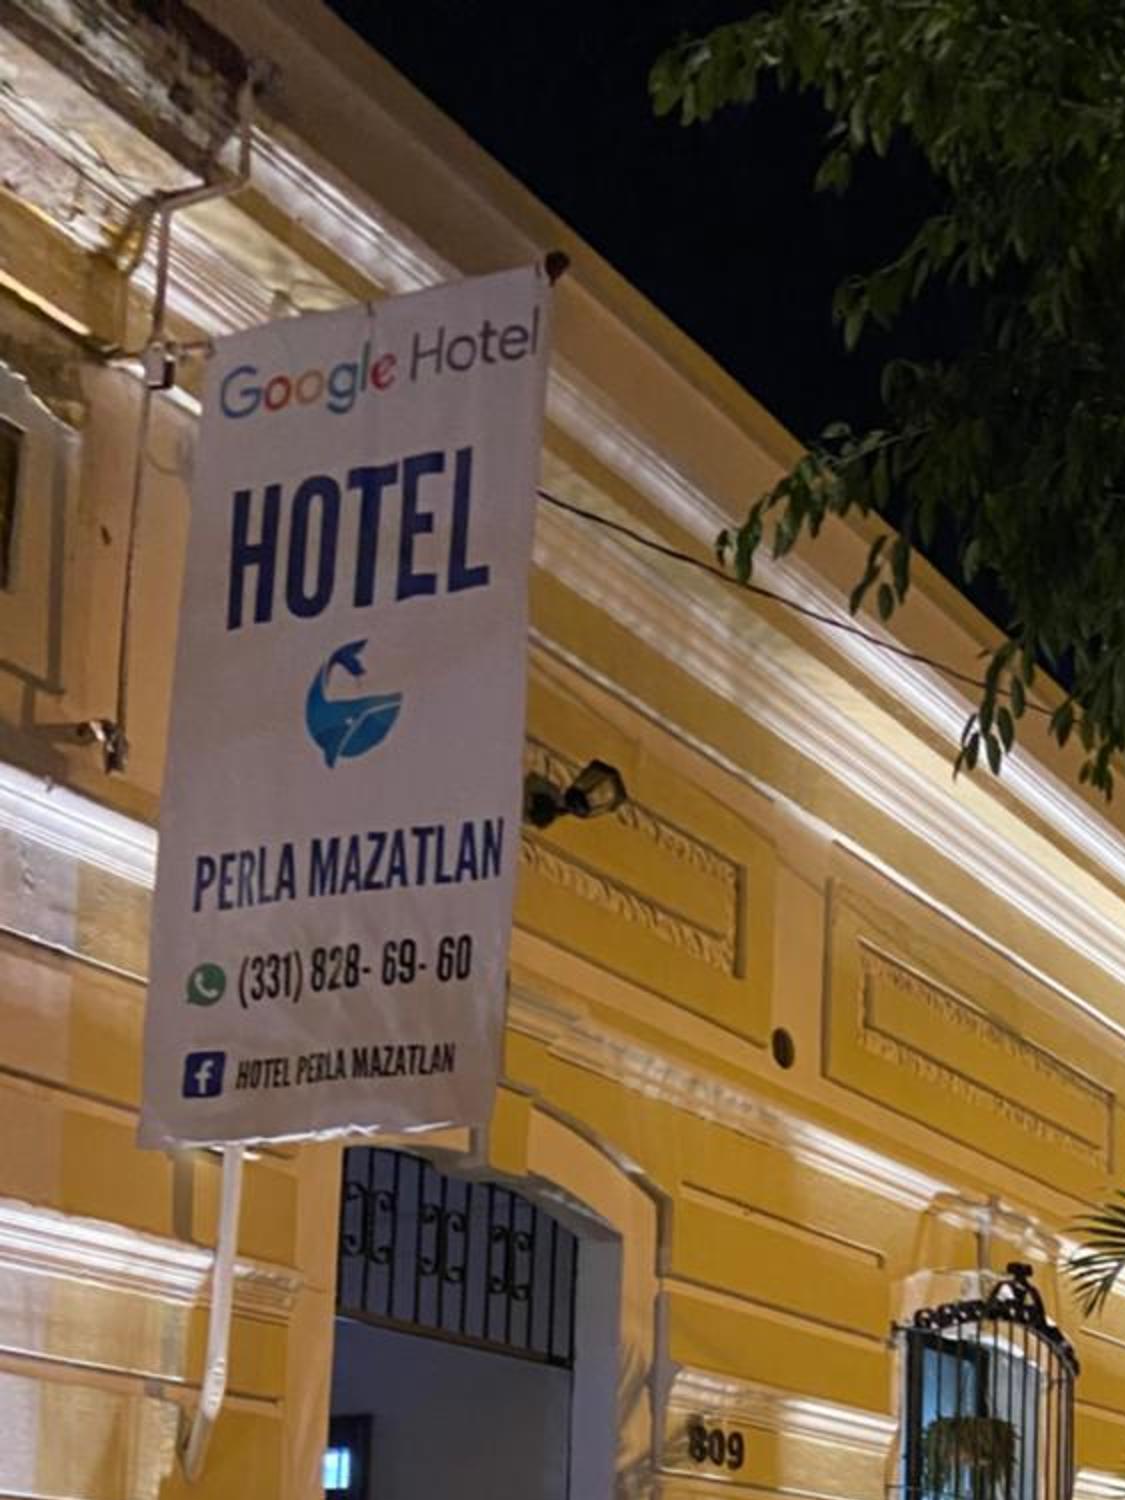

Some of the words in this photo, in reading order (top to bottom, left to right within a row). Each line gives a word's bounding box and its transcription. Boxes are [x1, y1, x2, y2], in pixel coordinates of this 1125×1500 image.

[219, 340, 397, 419] Google
[410, 305, 541, 381] Hotel
[226, 446, 490, 631] HOTEL
[192, 842, 296, 913] PERLA
[308, 816, 505, 898] MAZATLAN
[238, 949, 303, 1010] (331)
[436, 933, 473, 983] 60
[234, 1057, 291, 1090] HOTEL
[296, 1048, 347, 1087] PERLA
[351, 1041, 457, 1079] MAZATLAN
